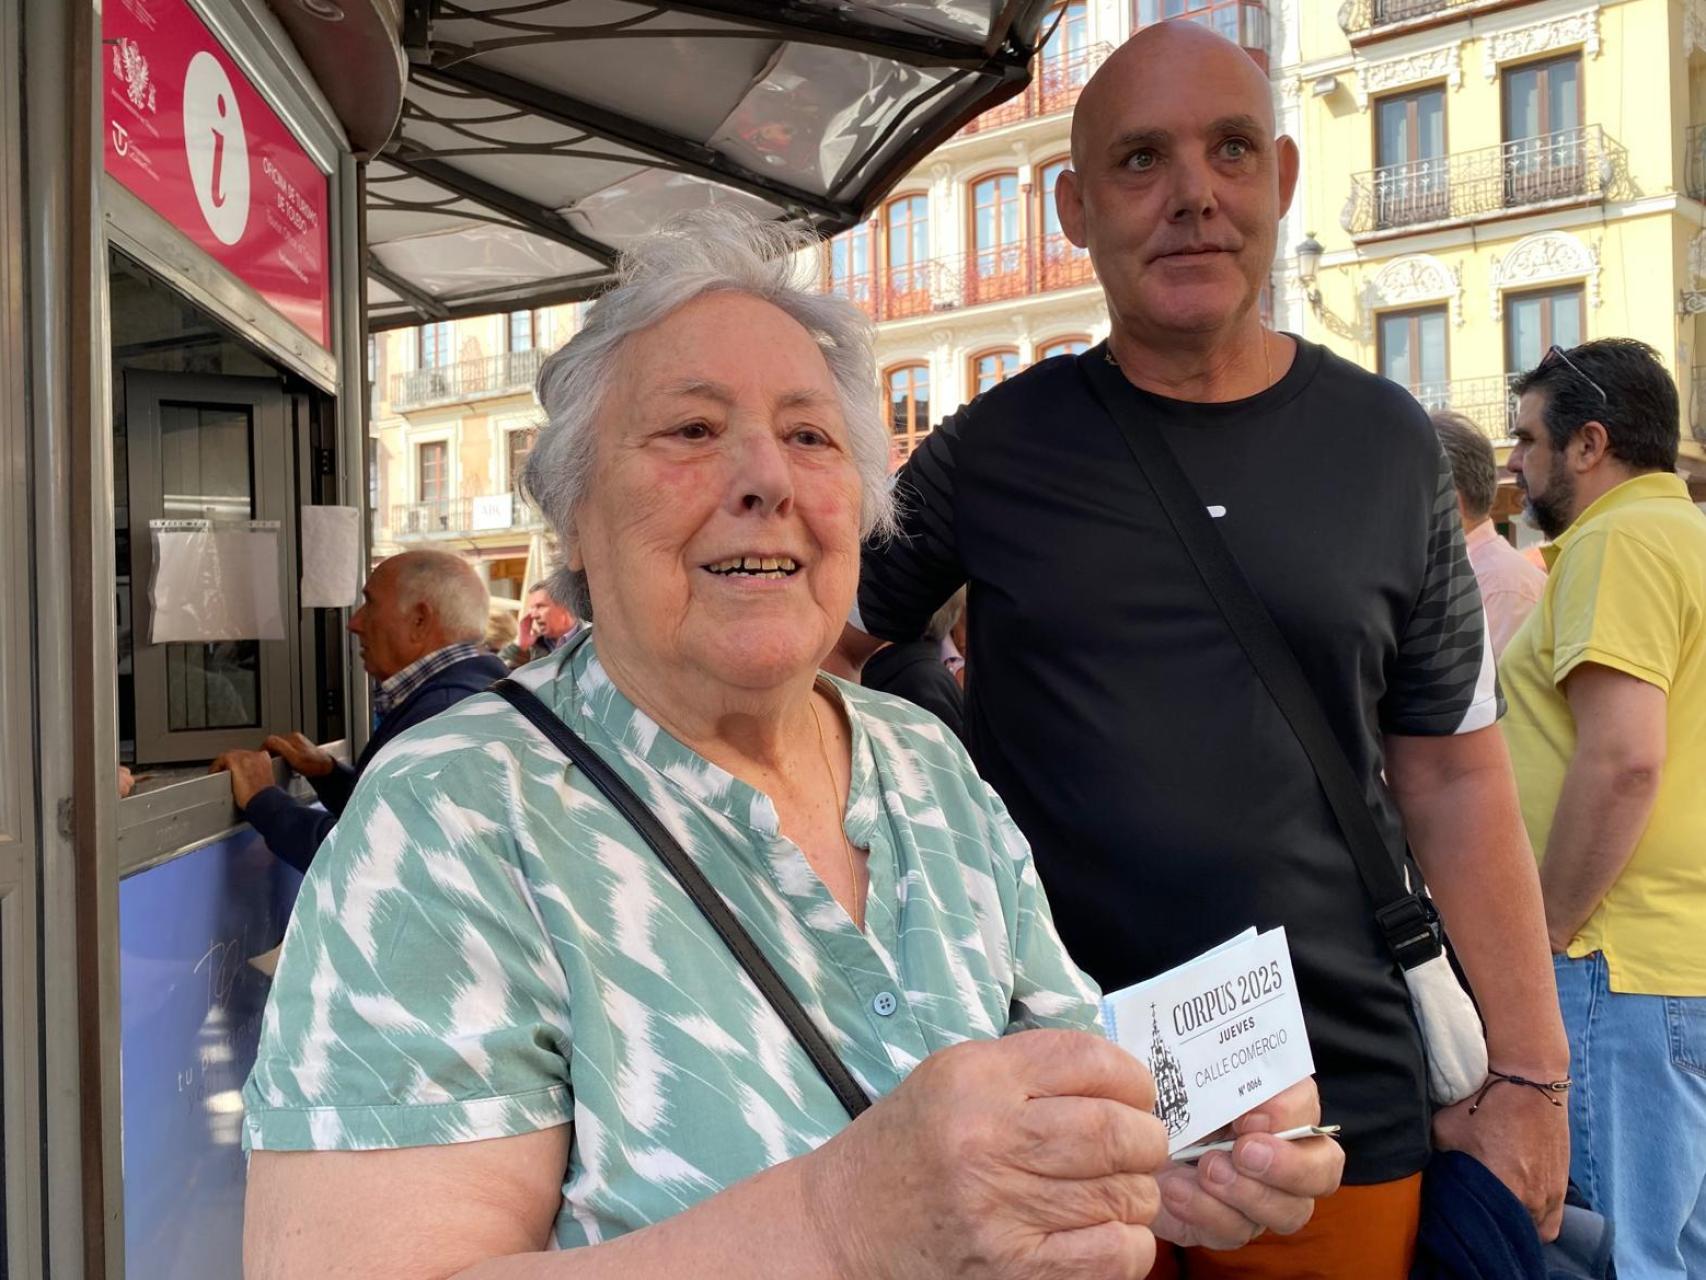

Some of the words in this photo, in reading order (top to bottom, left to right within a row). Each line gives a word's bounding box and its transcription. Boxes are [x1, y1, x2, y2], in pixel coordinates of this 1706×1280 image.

[1173, 981, 1237, 1036] CORPUS
[1238, 960, 1282, 1005] 2025
[1195, 1057, 1230, 1088] CALLE
[1231, 1028, 1288, 1069] COMERCIO
[1219, 1016, 1255, 1044] JUEVES
